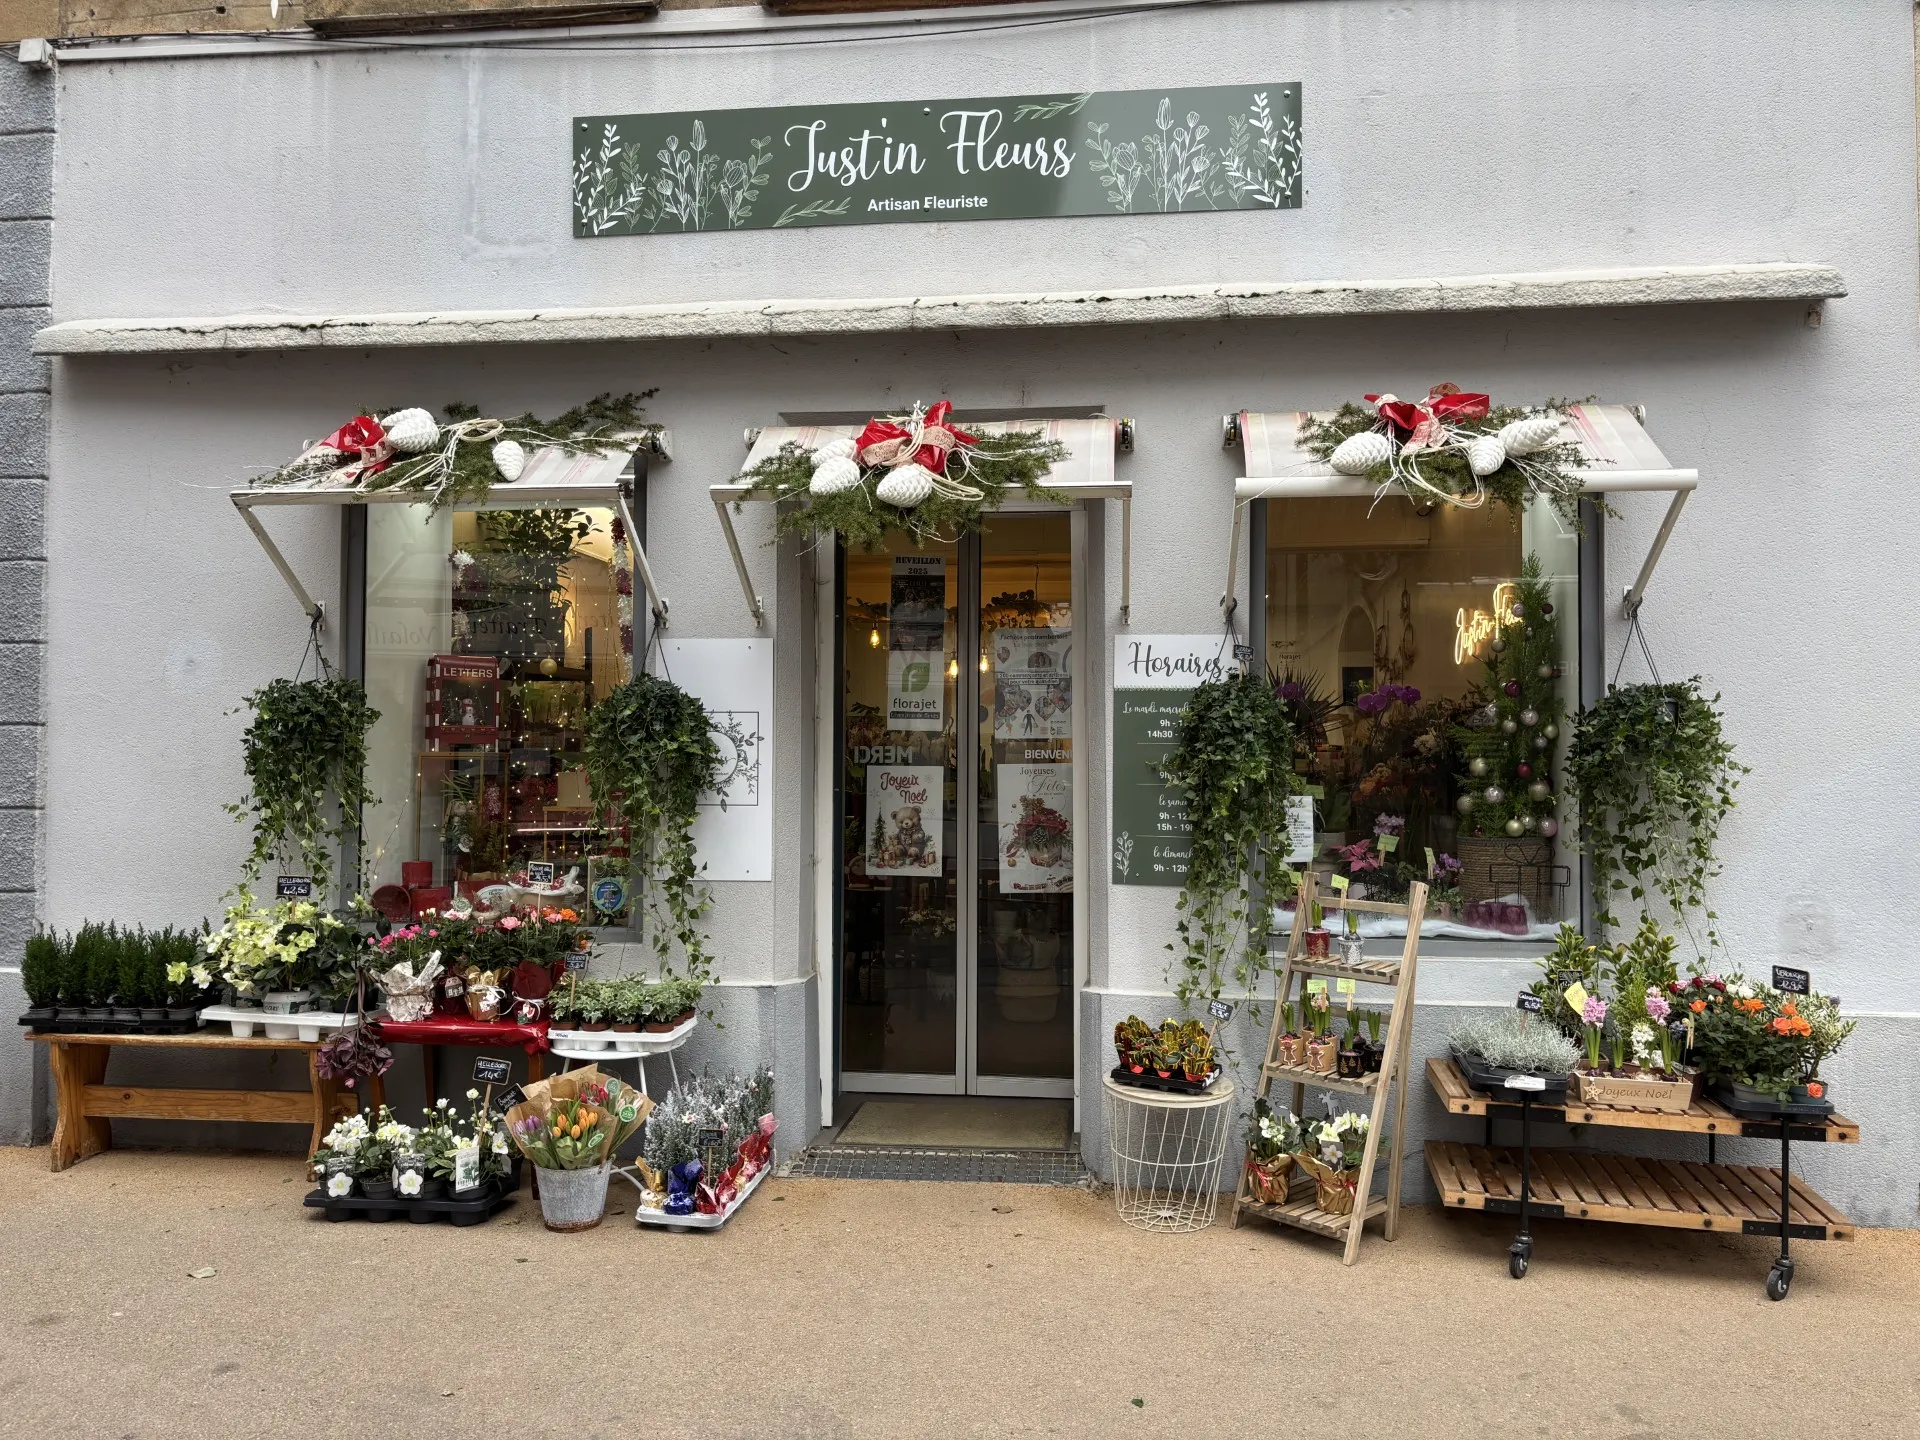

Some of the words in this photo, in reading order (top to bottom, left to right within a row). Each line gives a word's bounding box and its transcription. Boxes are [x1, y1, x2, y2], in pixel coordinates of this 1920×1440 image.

[784, 118, 926, 193] Justin
[940, 109, 1076, 180] Fleurs
[868, 197, 921, 211] Artisan
[924, 194, 988, 211] Fleuriste
[895, 556, 941, 565] REVEILLON
[1128, 641, 1225, 679] Horaires
[443, 667, 493, 679] LETTERS
[893, 698, 937, 711] florajet
[1122, 701, 1132, 714] Le
[1160, 719, 1170, 727] 9h
[1147, 730, 1173, 738] 14h30
[1020, 767, 1055, 780] Joyeuses
[1159, 771, 1170, 779] 9h
[880, 772, 919, 791] Joyeux
[1158, 793, 1167, 806] le
[1159, 812, 1169, 820] 9h
[1156, 823, 1172, 831] 15h
[1153, 845, 1161, 858] le
[1153, 864, 1164, 872] 9h
[1172, 865, 1190, 873] 12h
[1599, 1085, 1641, 1099] Joyeux
[1645, 1089, 1673, 1100] Noël
